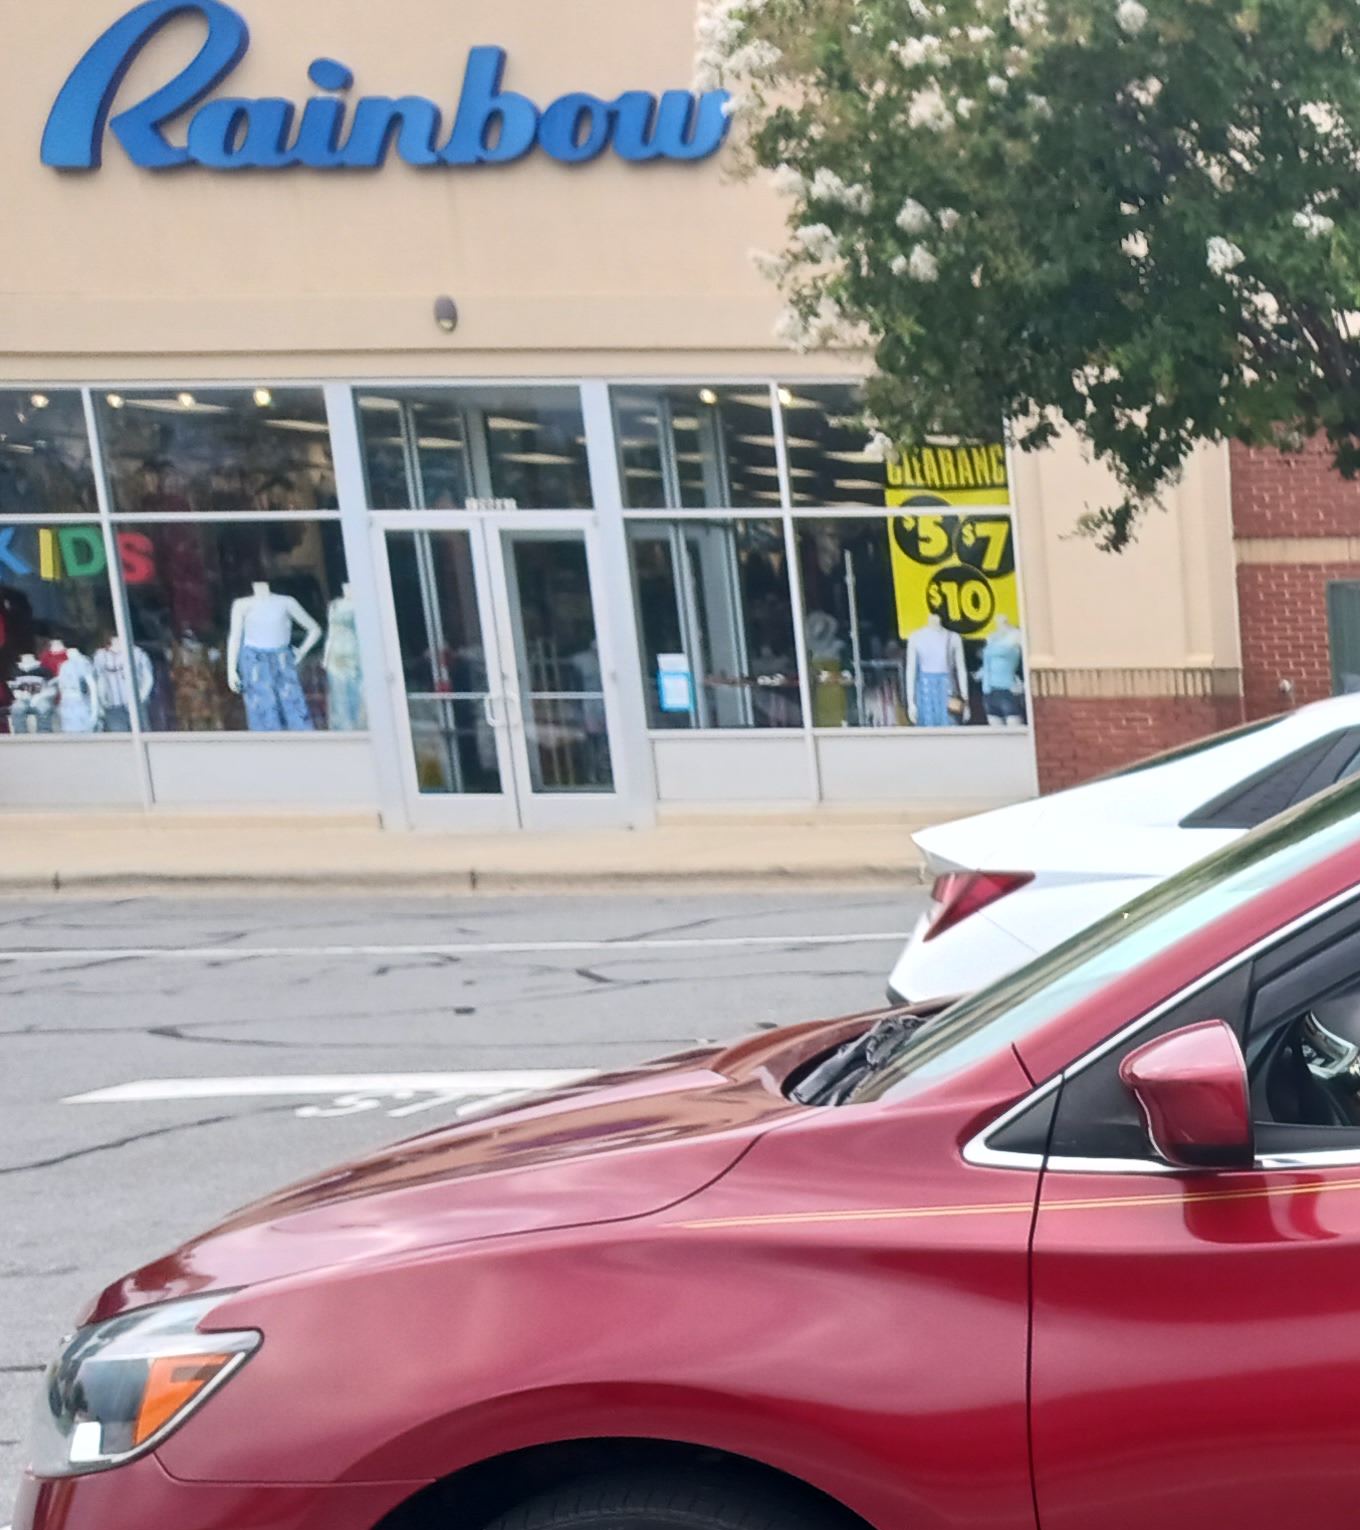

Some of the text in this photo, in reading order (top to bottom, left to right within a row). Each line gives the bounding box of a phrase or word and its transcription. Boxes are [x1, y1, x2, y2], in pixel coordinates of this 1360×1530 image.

[40, 0, 732, 168] Rainbow
[886, 444, 1005, 486] CLEARANC
[961, 520, 1010, 571] $7
[928, 579, 992, 622] $10
